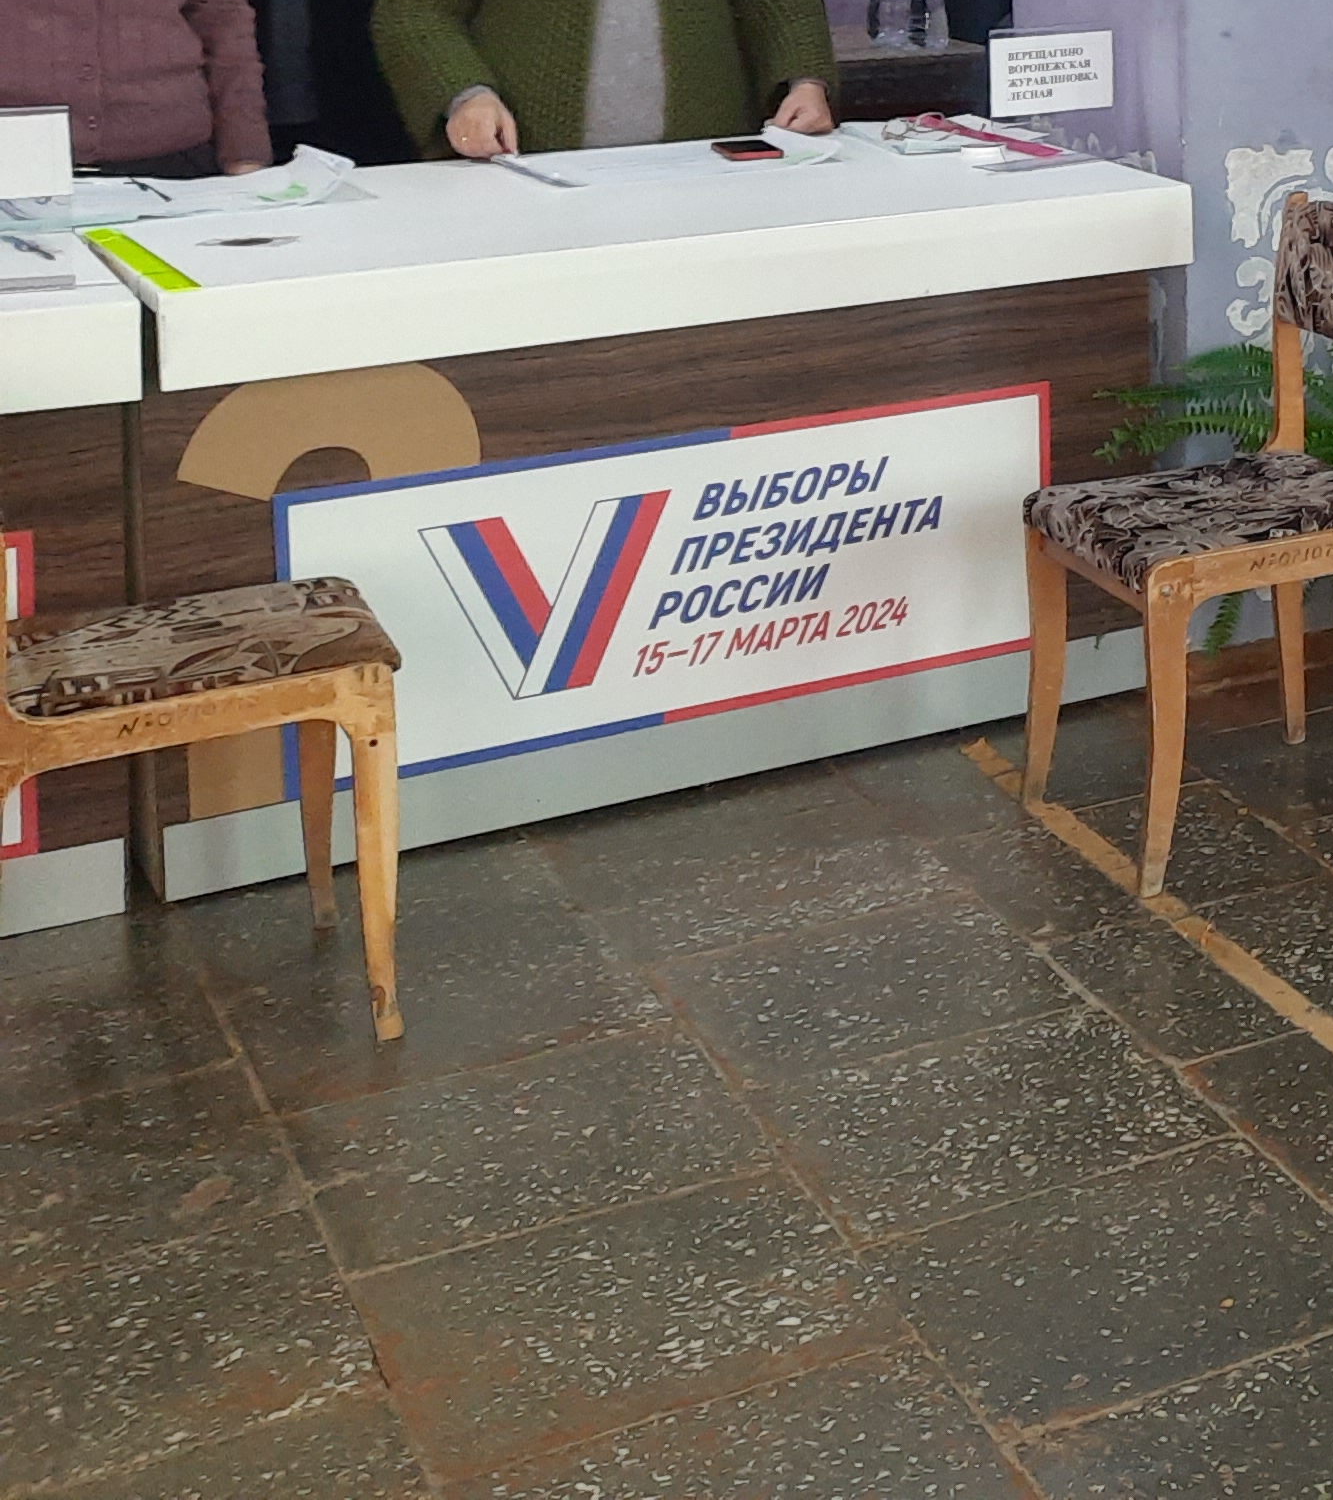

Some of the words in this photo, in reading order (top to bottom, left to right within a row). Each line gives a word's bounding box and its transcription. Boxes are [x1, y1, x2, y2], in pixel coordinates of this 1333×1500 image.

[1008, 47, 1084, 61] ВЕРЕЩАГИНО
[1008, 59, 1091, 74] ВОРОНЕЖСКАЯ
[1008, 88, 1053, 101] ЛЕСНАЯ
[693, 456, 889, 521] ВЫБОРЫ
[670, 496, 943, 575] ПРЕЗИДЕНТА
[418, 489, 671, 700] V
[648, 563, 830, 630] РОССИИ
[724, 610, 832, 659] МАРТА
[835, 596, 909, 638] 2024
